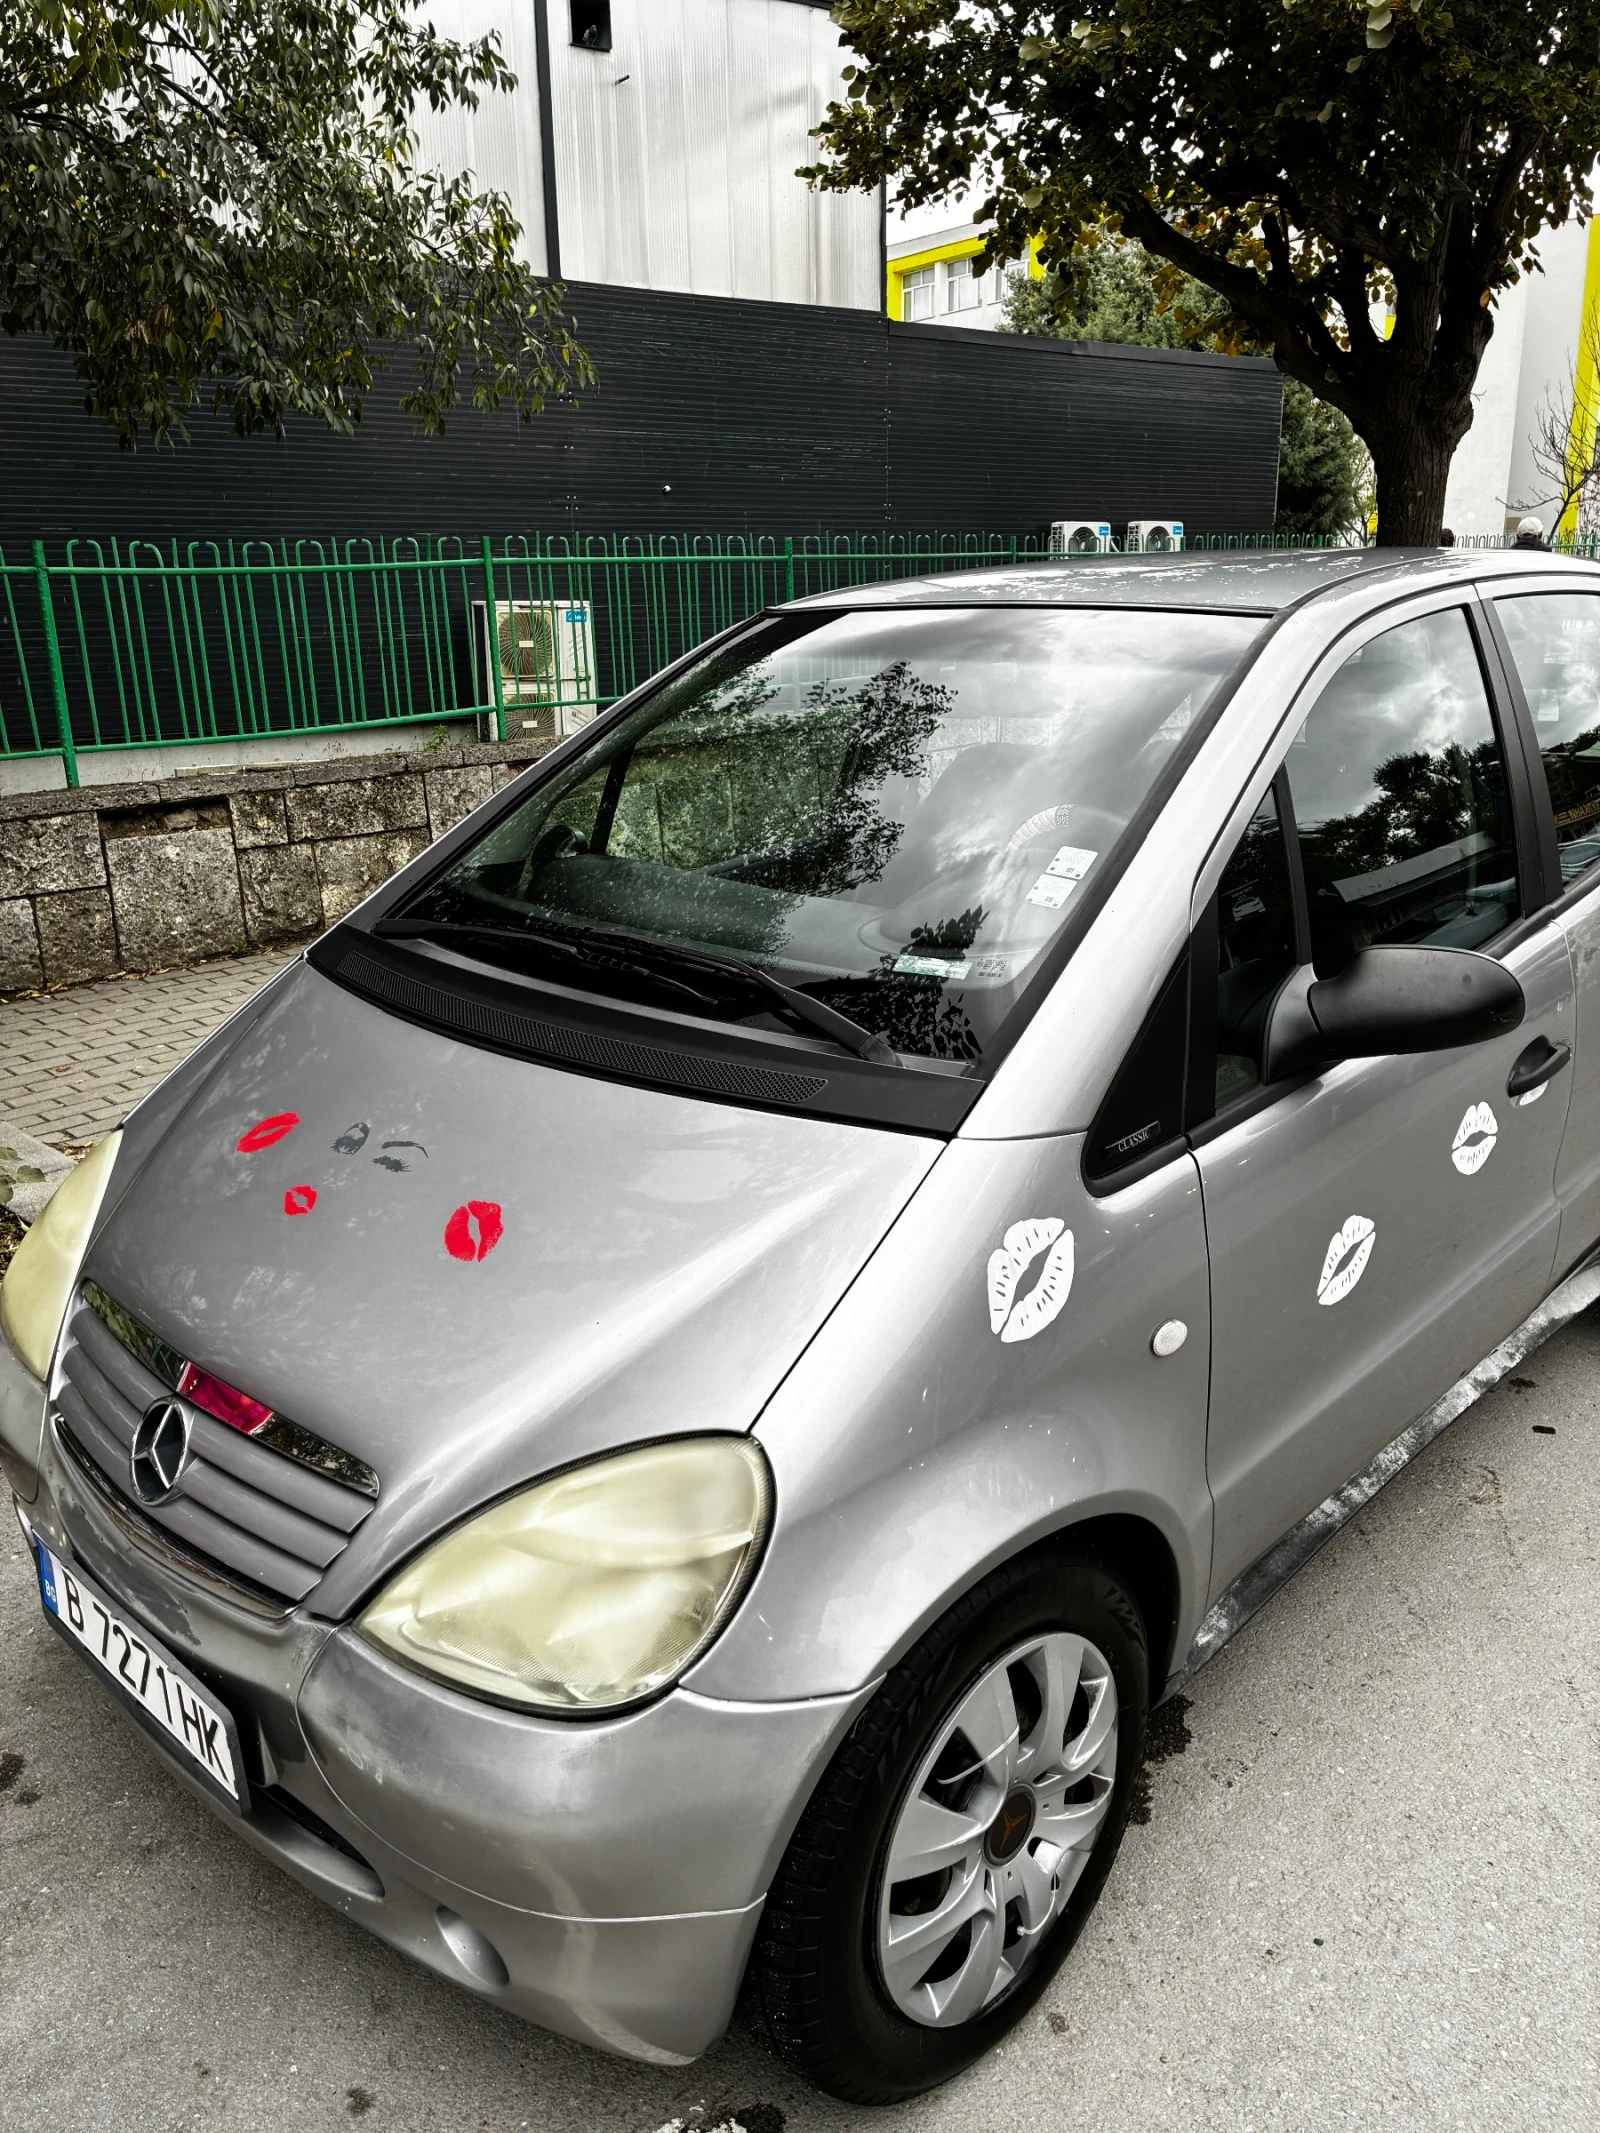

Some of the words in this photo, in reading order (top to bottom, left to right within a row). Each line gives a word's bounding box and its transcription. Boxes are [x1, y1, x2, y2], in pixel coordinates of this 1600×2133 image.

[1118, 1128, 1150, 1152] CLASSIC
[44, 1578, 57, 1603] BG
[61, 1565, 84, 1632] B
[93, 1602, 174, 1726] 7271
[176, 1682, 230, 1786] HK
